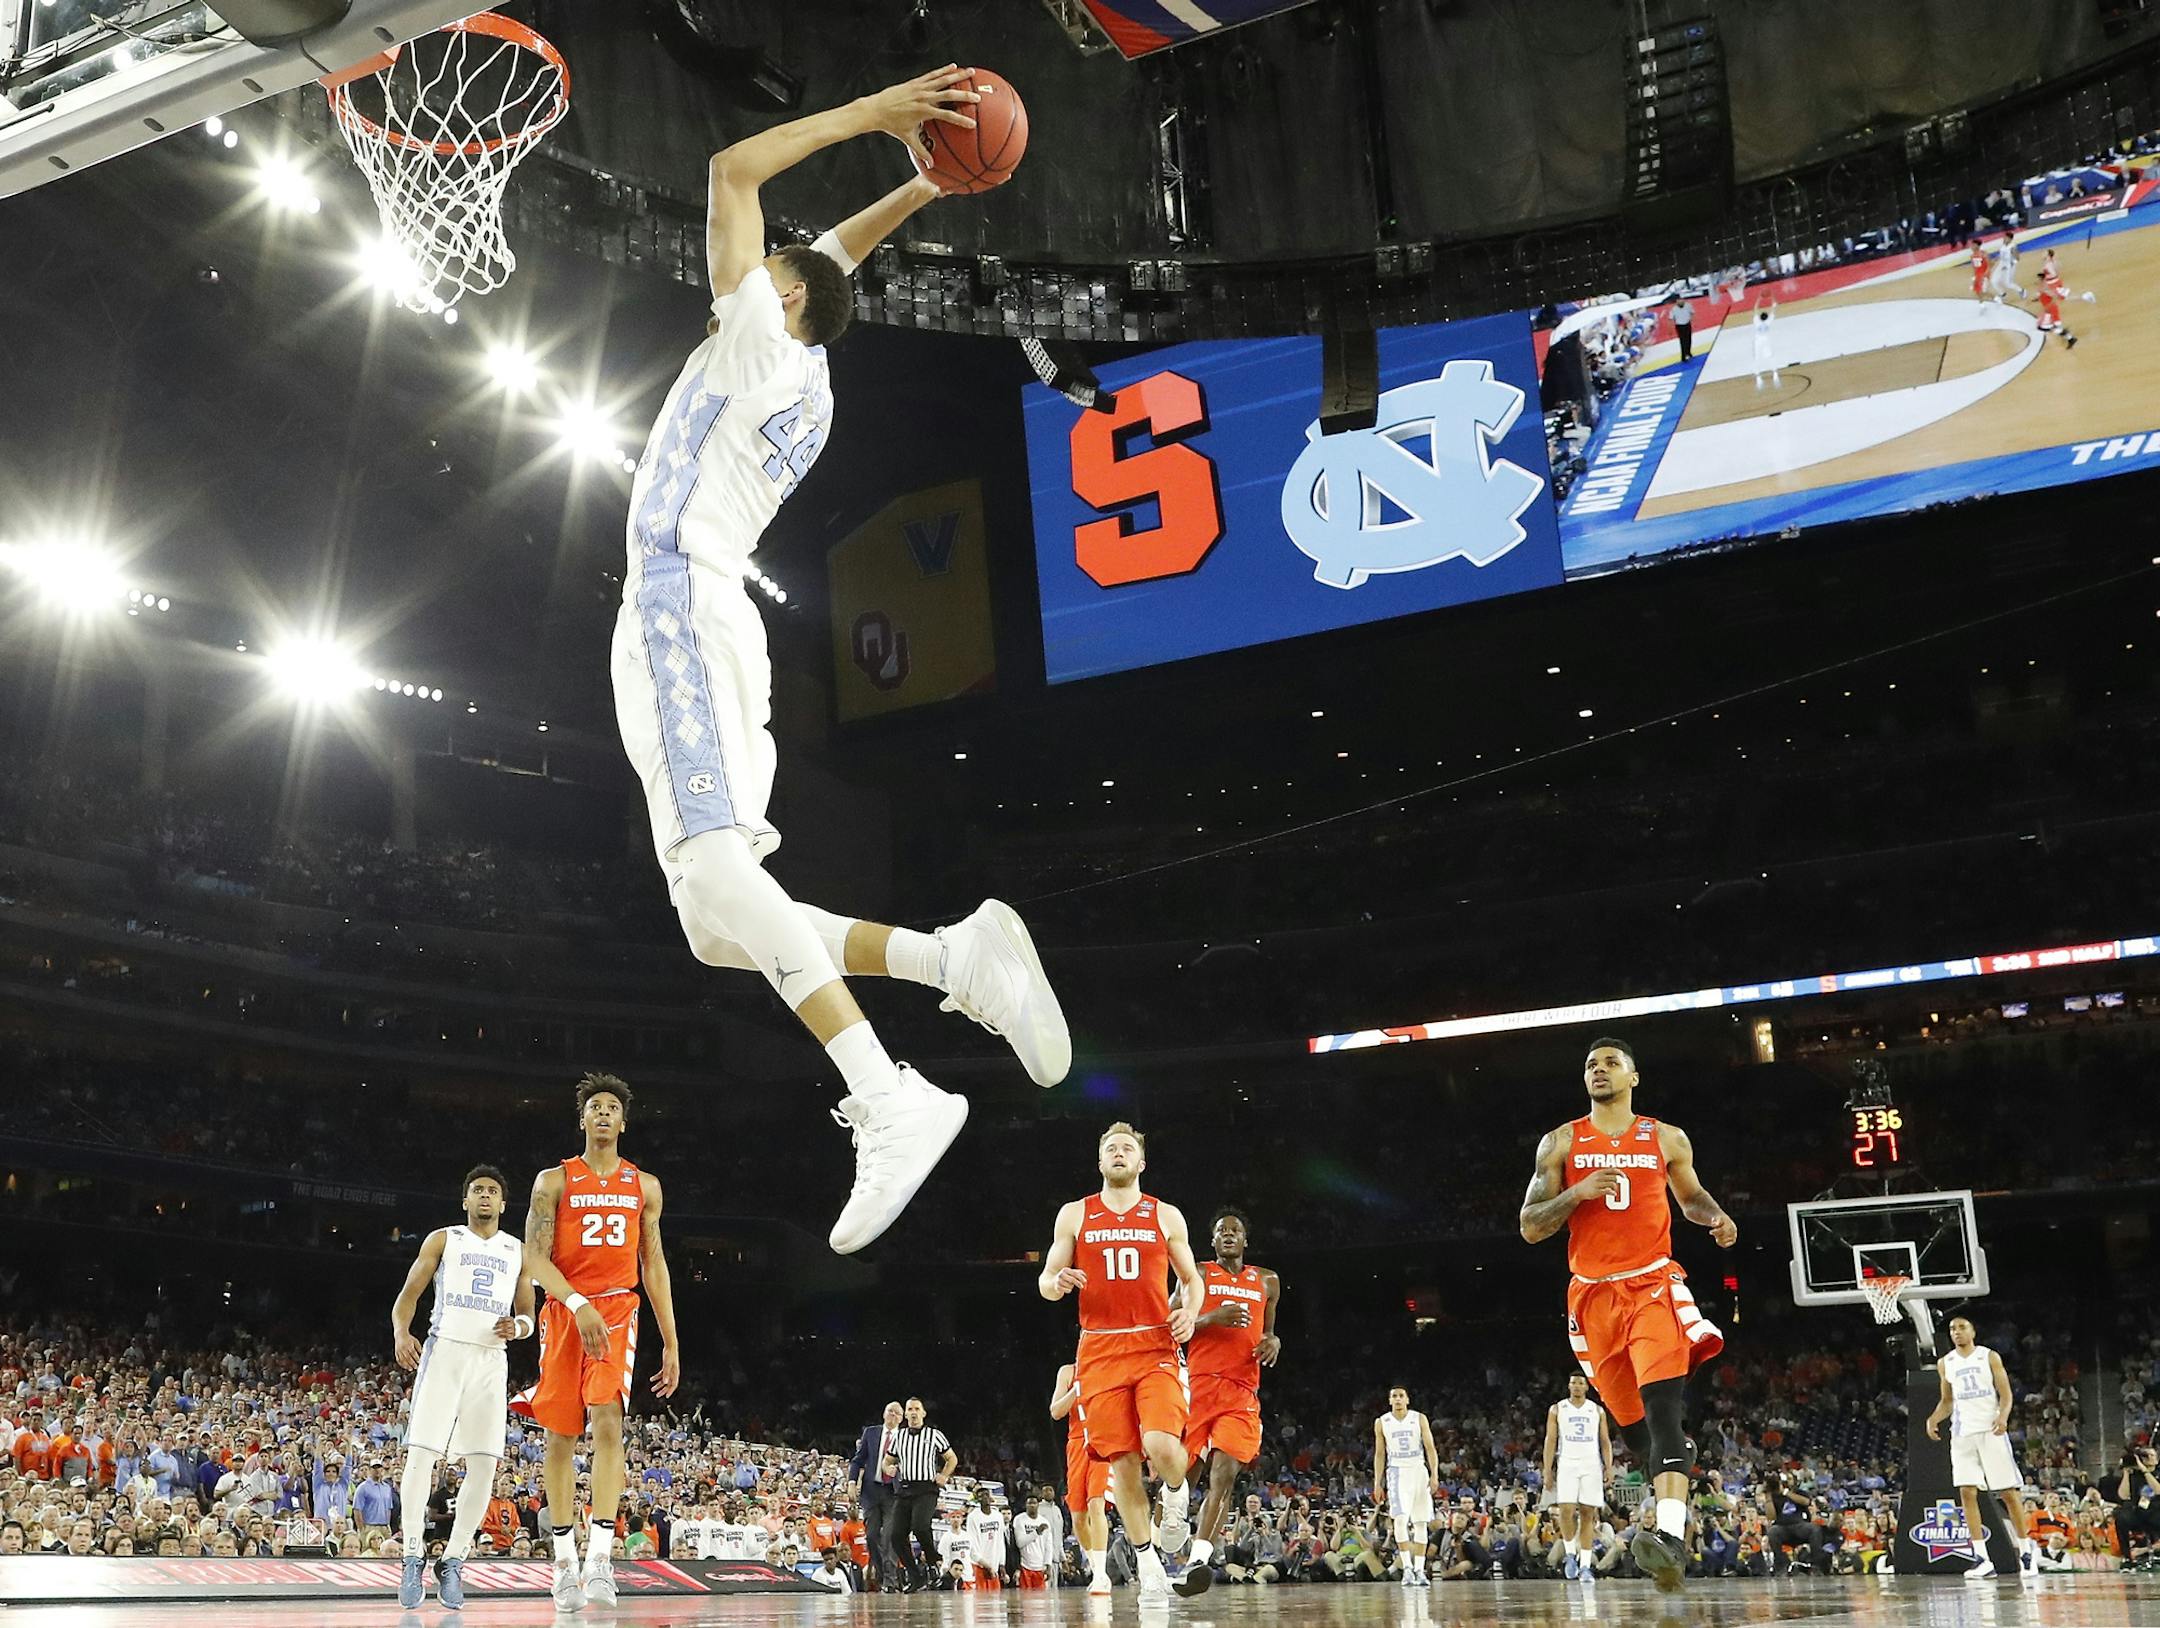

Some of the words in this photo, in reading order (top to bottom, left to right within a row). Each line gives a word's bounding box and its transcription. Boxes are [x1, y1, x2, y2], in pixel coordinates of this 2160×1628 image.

[1618, 371, 1683, 418] FOUR
[1594, 413, 1664, 466] FINAL
[1069, 369, 1222, 588] S
[1568, 461, 1643, 516] NCAA
[1855, 1108, 1903, 1132] 3:36
[1855, 1131, 1898, 1166] 27
[1574, 1153, 1658, 1170] SYRACUSE
[569, 1193, 639, 1211] SYRACUSE
[581, 1213, 627, 1247] 23
[1084, 1228, 1157, 1245] SYRACUSE
[460, 1252, 509, 1275] NORTH
[1102, 1246, 1141, 1281] 10
[472, 1267, 495, 1297] 2
[1208, 1284, 1262, 1303] SYRACUSE
[445, 1292, 511, 1317] CAROLINA
[1961, 1374, 1980, 1392] 11
[1574, 1423, 1585, 1436] 3
[1397, 1437, 1410, 1451] 5
[1918, 1527, 1951, 1540] FINAL
[1951, 1527, 1972, 1540] FOU
